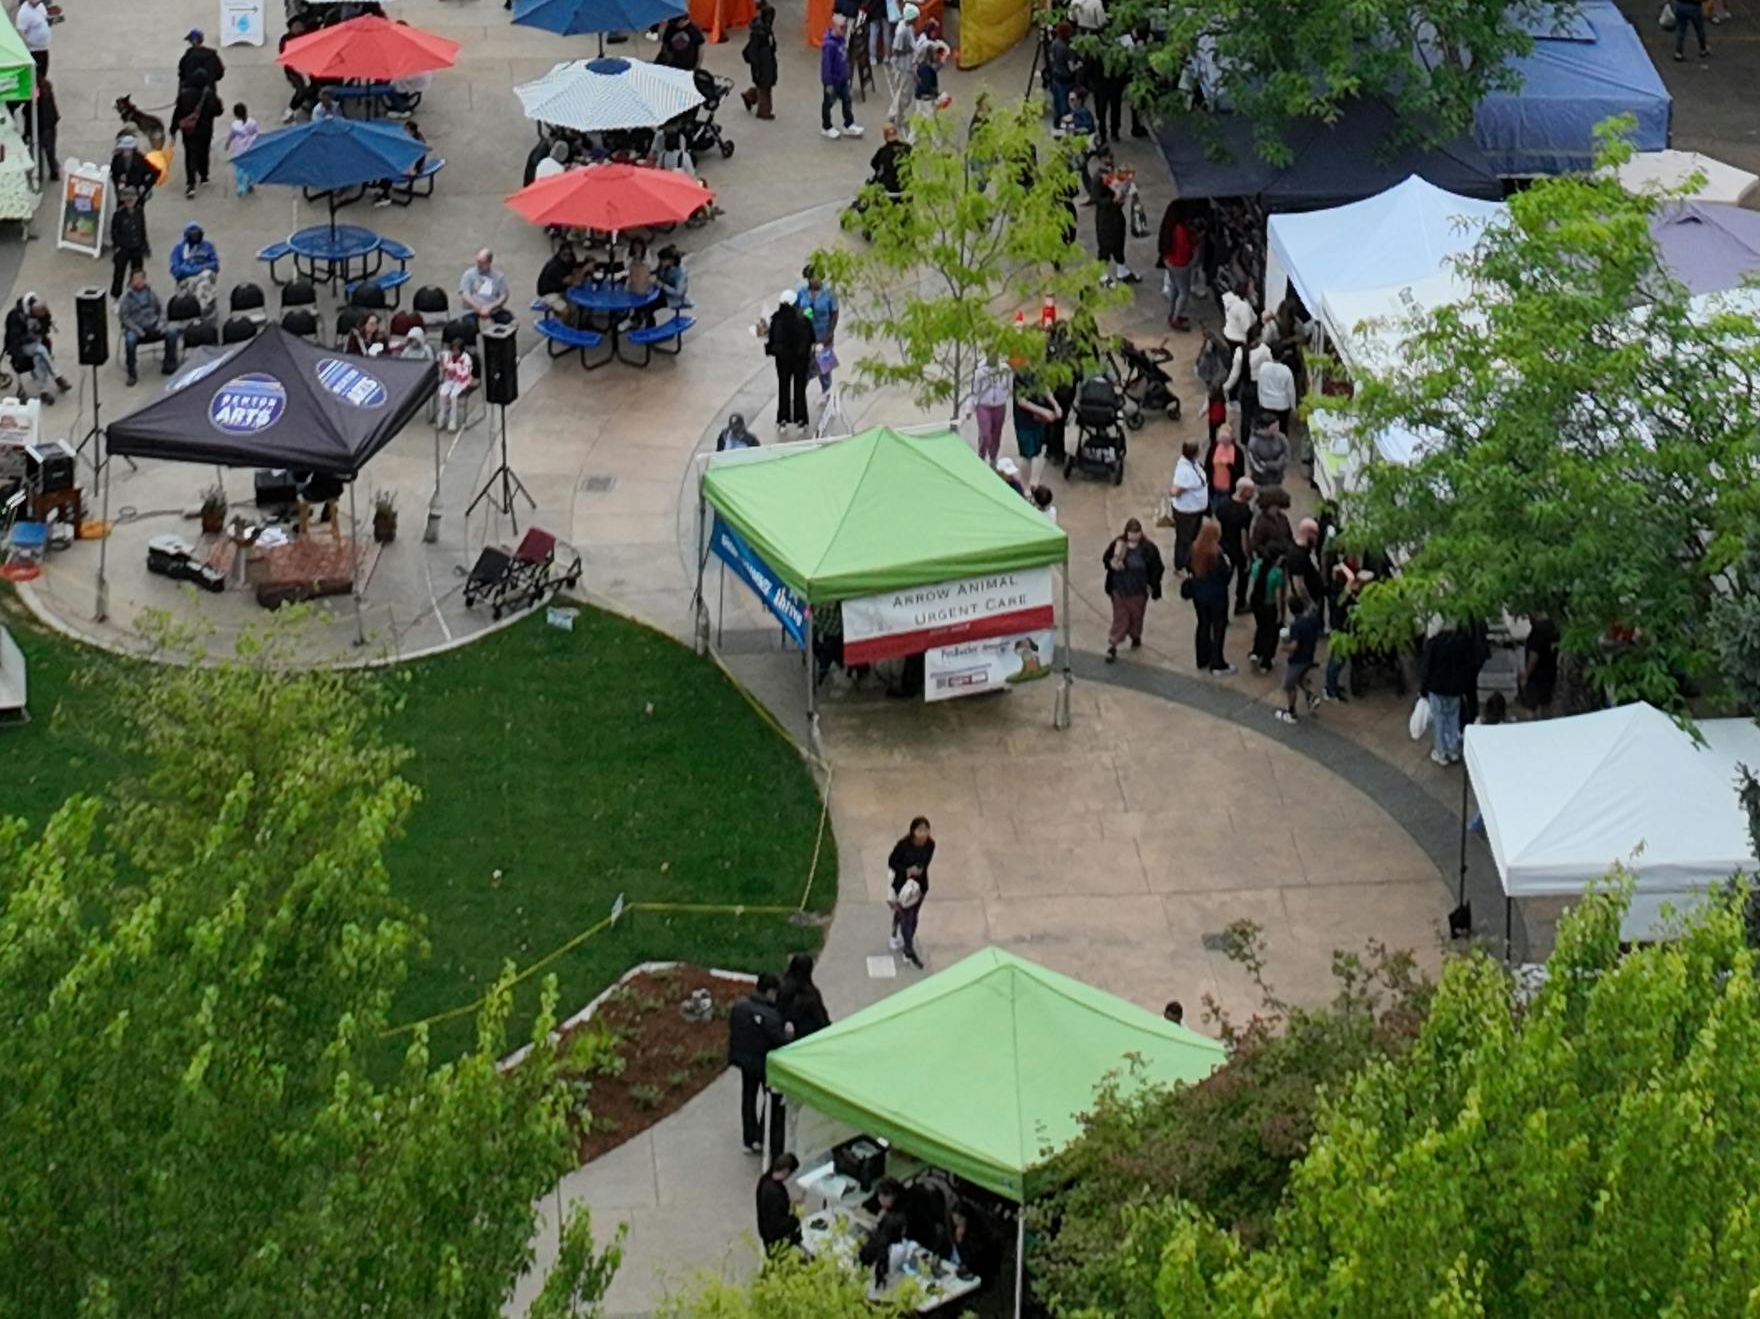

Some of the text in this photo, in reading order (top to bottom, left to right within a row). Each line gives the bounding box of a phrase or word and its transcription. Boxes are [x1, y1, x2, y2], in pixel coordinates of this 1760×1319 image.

[216, 406, 272, 429] ARTS
[892, 575, 1018, 609] ARROW ANIMAL
[914, 594, 1028, 626] URGENT CARE
